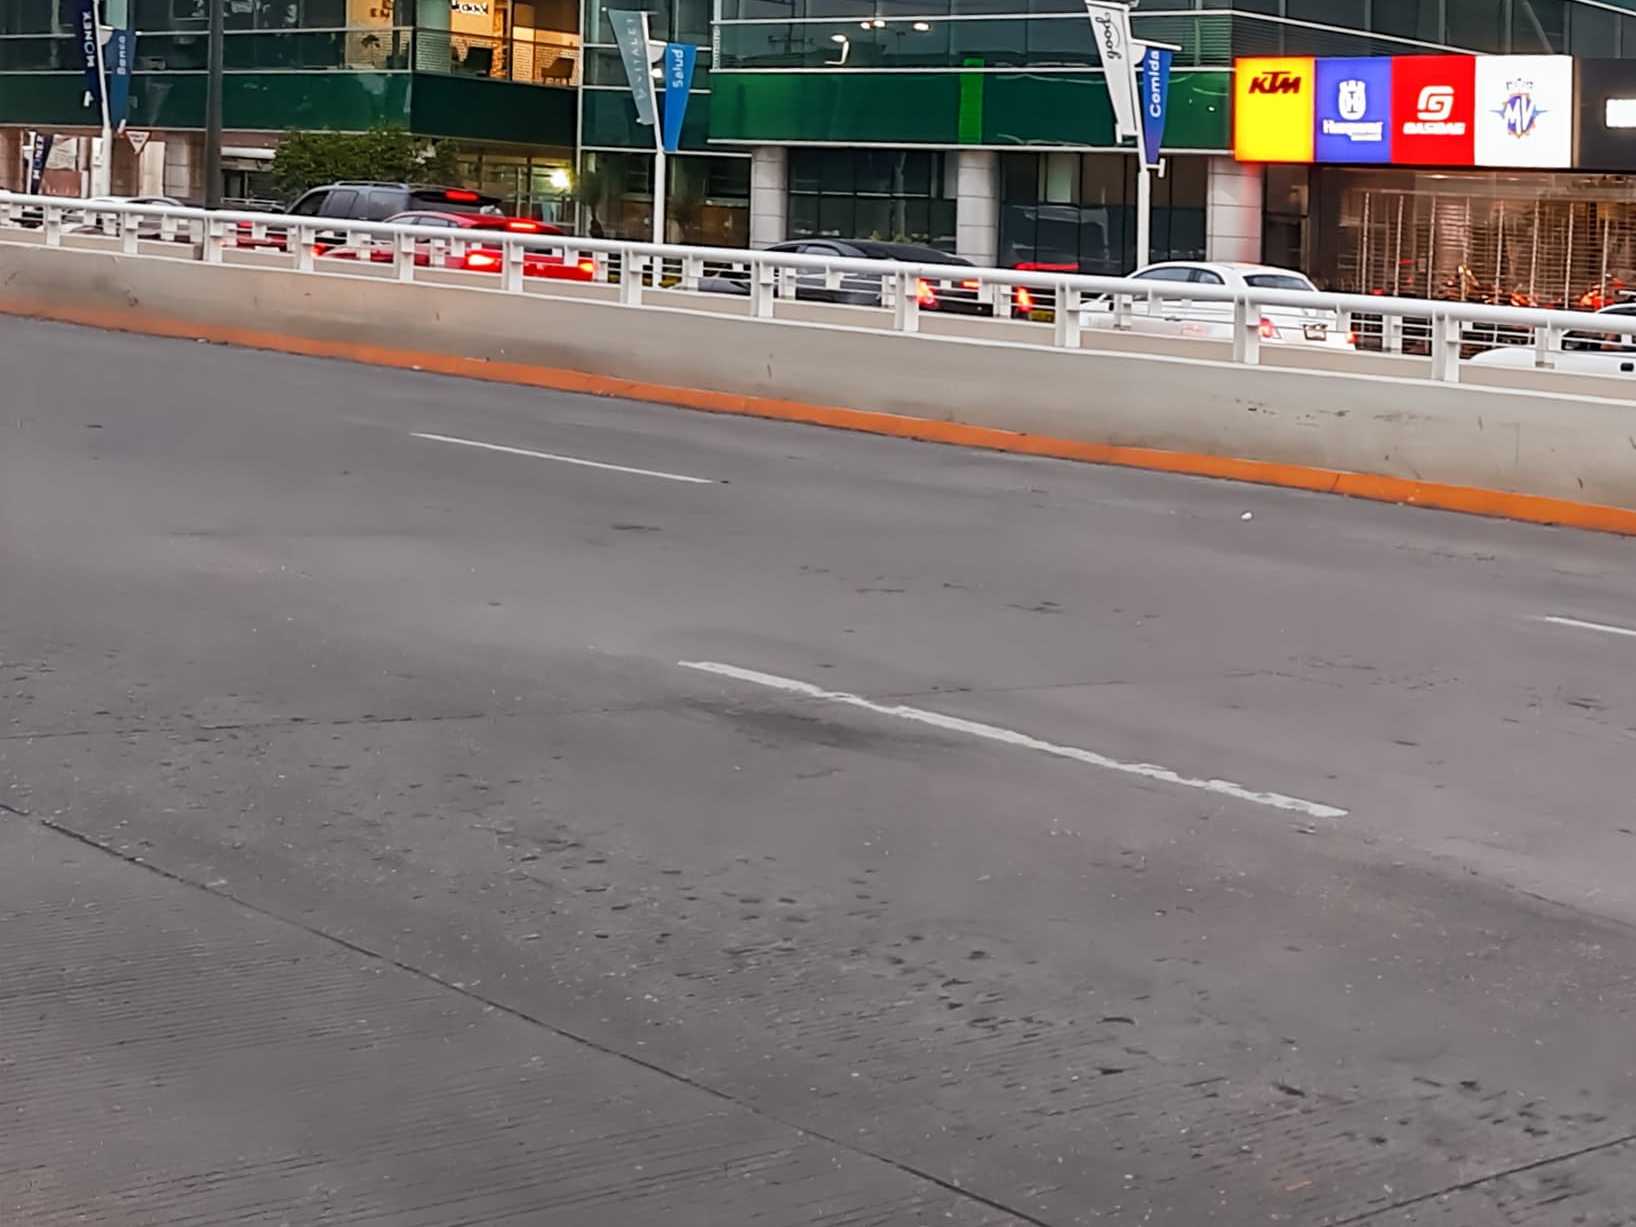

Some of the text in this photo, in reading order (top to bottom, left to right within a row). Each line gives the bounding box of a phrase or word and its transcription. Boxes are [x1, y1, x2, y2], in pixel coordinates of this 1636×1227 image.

[82, 11, 95, 68] MONEX
[1095, 12, 1122, 60] good
[671, 48, 684, 88] Salud
[1148, 50, 1162, 118] Comida
[1248, 71, 1302, 94] KTM
